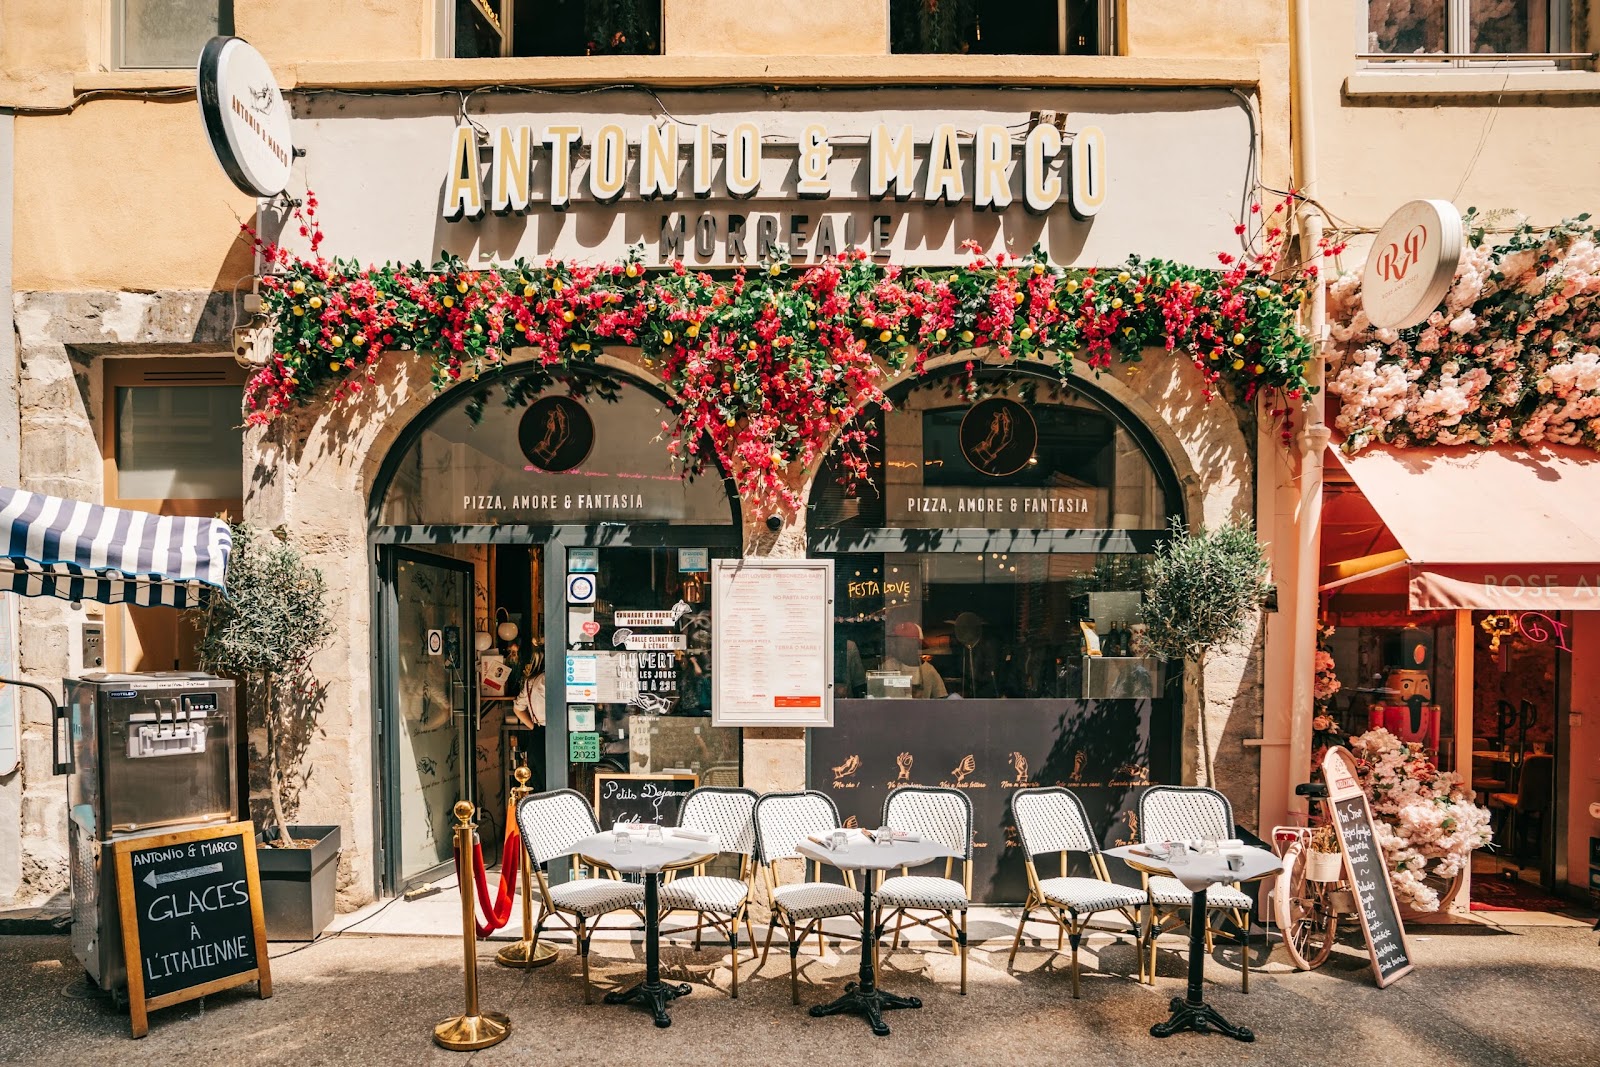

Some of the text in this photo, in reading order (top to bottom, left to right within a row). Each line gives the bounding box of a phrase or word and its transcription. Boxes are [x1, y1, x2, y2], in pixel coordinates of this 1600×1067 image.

[231, 95, 260, 135] ANTONIO
[268, 135, 288, 168] MARCO
[443, 123, 1107, 222] ANTONIO & MARCO
[463, 494, 643, 511] PIZZA, AMORE & FANTASIA
[907, 498, 1088, 513] PIZZA, AMORE & FANTASIA
[848, 581, 910, 598] FESTA LOVE
[1484, 574, 1600, 598] ROSE A
[619, 652, 676, 669] OUVERT
[639, 670, 652, 679] LES
[654, 670, 677, 679] JOURS
[650, 679, 657, 691] À
[573, 751, 596, 759] 2023
[603, 781, 637, 800] Petits
[188, 843, 196, 858] &
[201, 841, 238, 857] MARCO
[147, 880, 249, 921] GLACES
[191, 922, 201, 940] À
[146, 936, 249, 980] L'ITALIENNE
